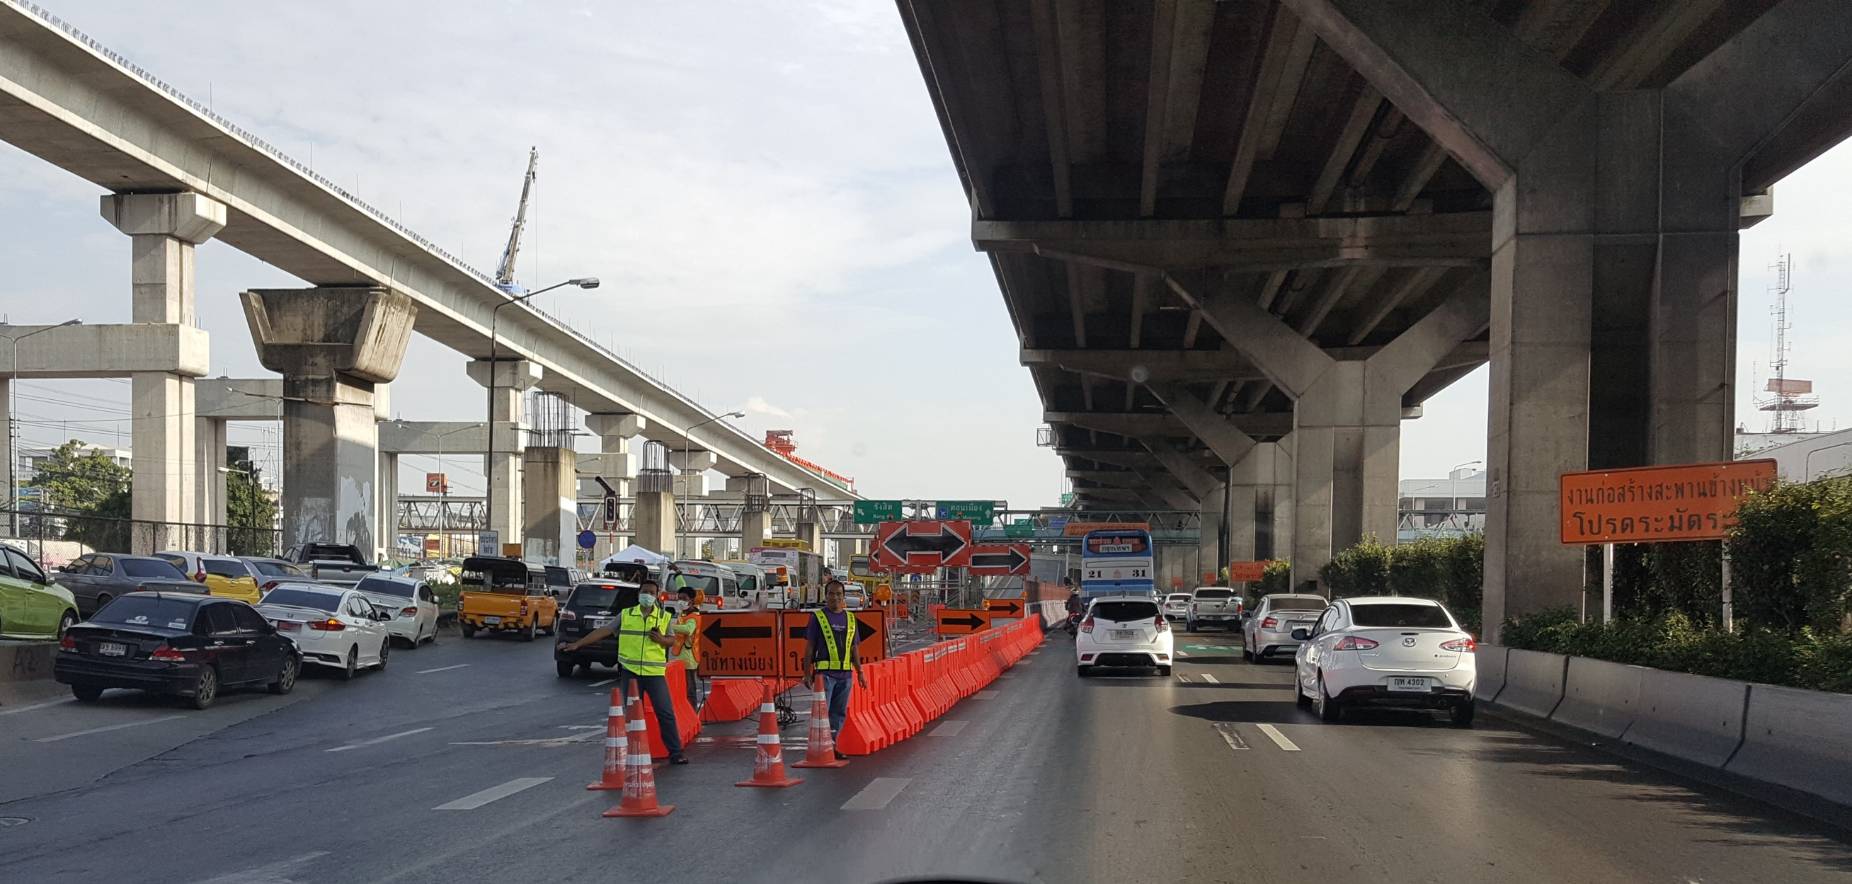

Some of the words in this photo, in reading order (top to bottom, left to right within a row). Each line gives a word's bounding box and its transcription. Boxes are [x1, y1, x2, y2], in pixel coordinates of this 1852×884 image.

[1088, 570, 1102, 578] 21
[1132, 569, 1146, 577] 31
[702, 646, 774, 672] ใช้ทางเบี่ยง
[1407, 678, 1425, 686] 4302
